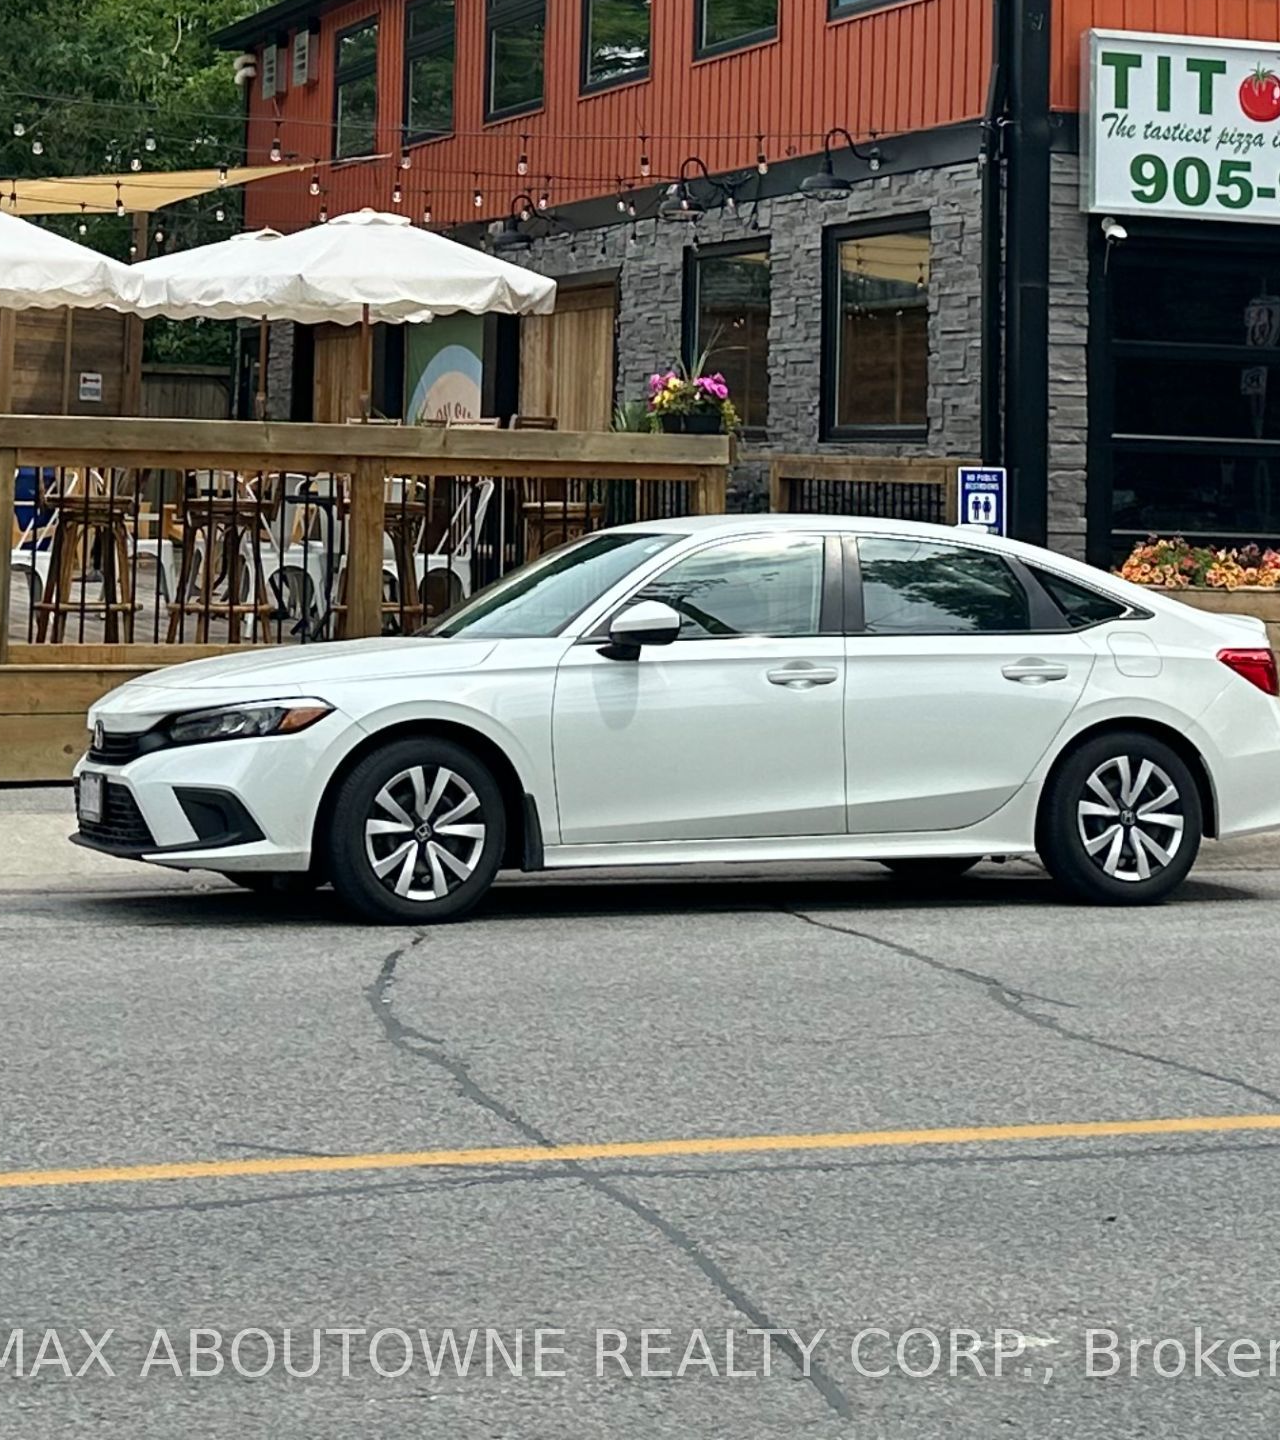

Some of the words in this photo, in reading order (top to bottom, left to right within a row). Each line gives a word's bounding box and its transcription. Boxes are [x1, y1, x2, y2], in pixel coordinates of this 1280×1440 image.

[1101, 112, 1137, 139] The
[1142, 120, 1213, 144] tastiest
[1215, 126, 1267, 155] pizza
